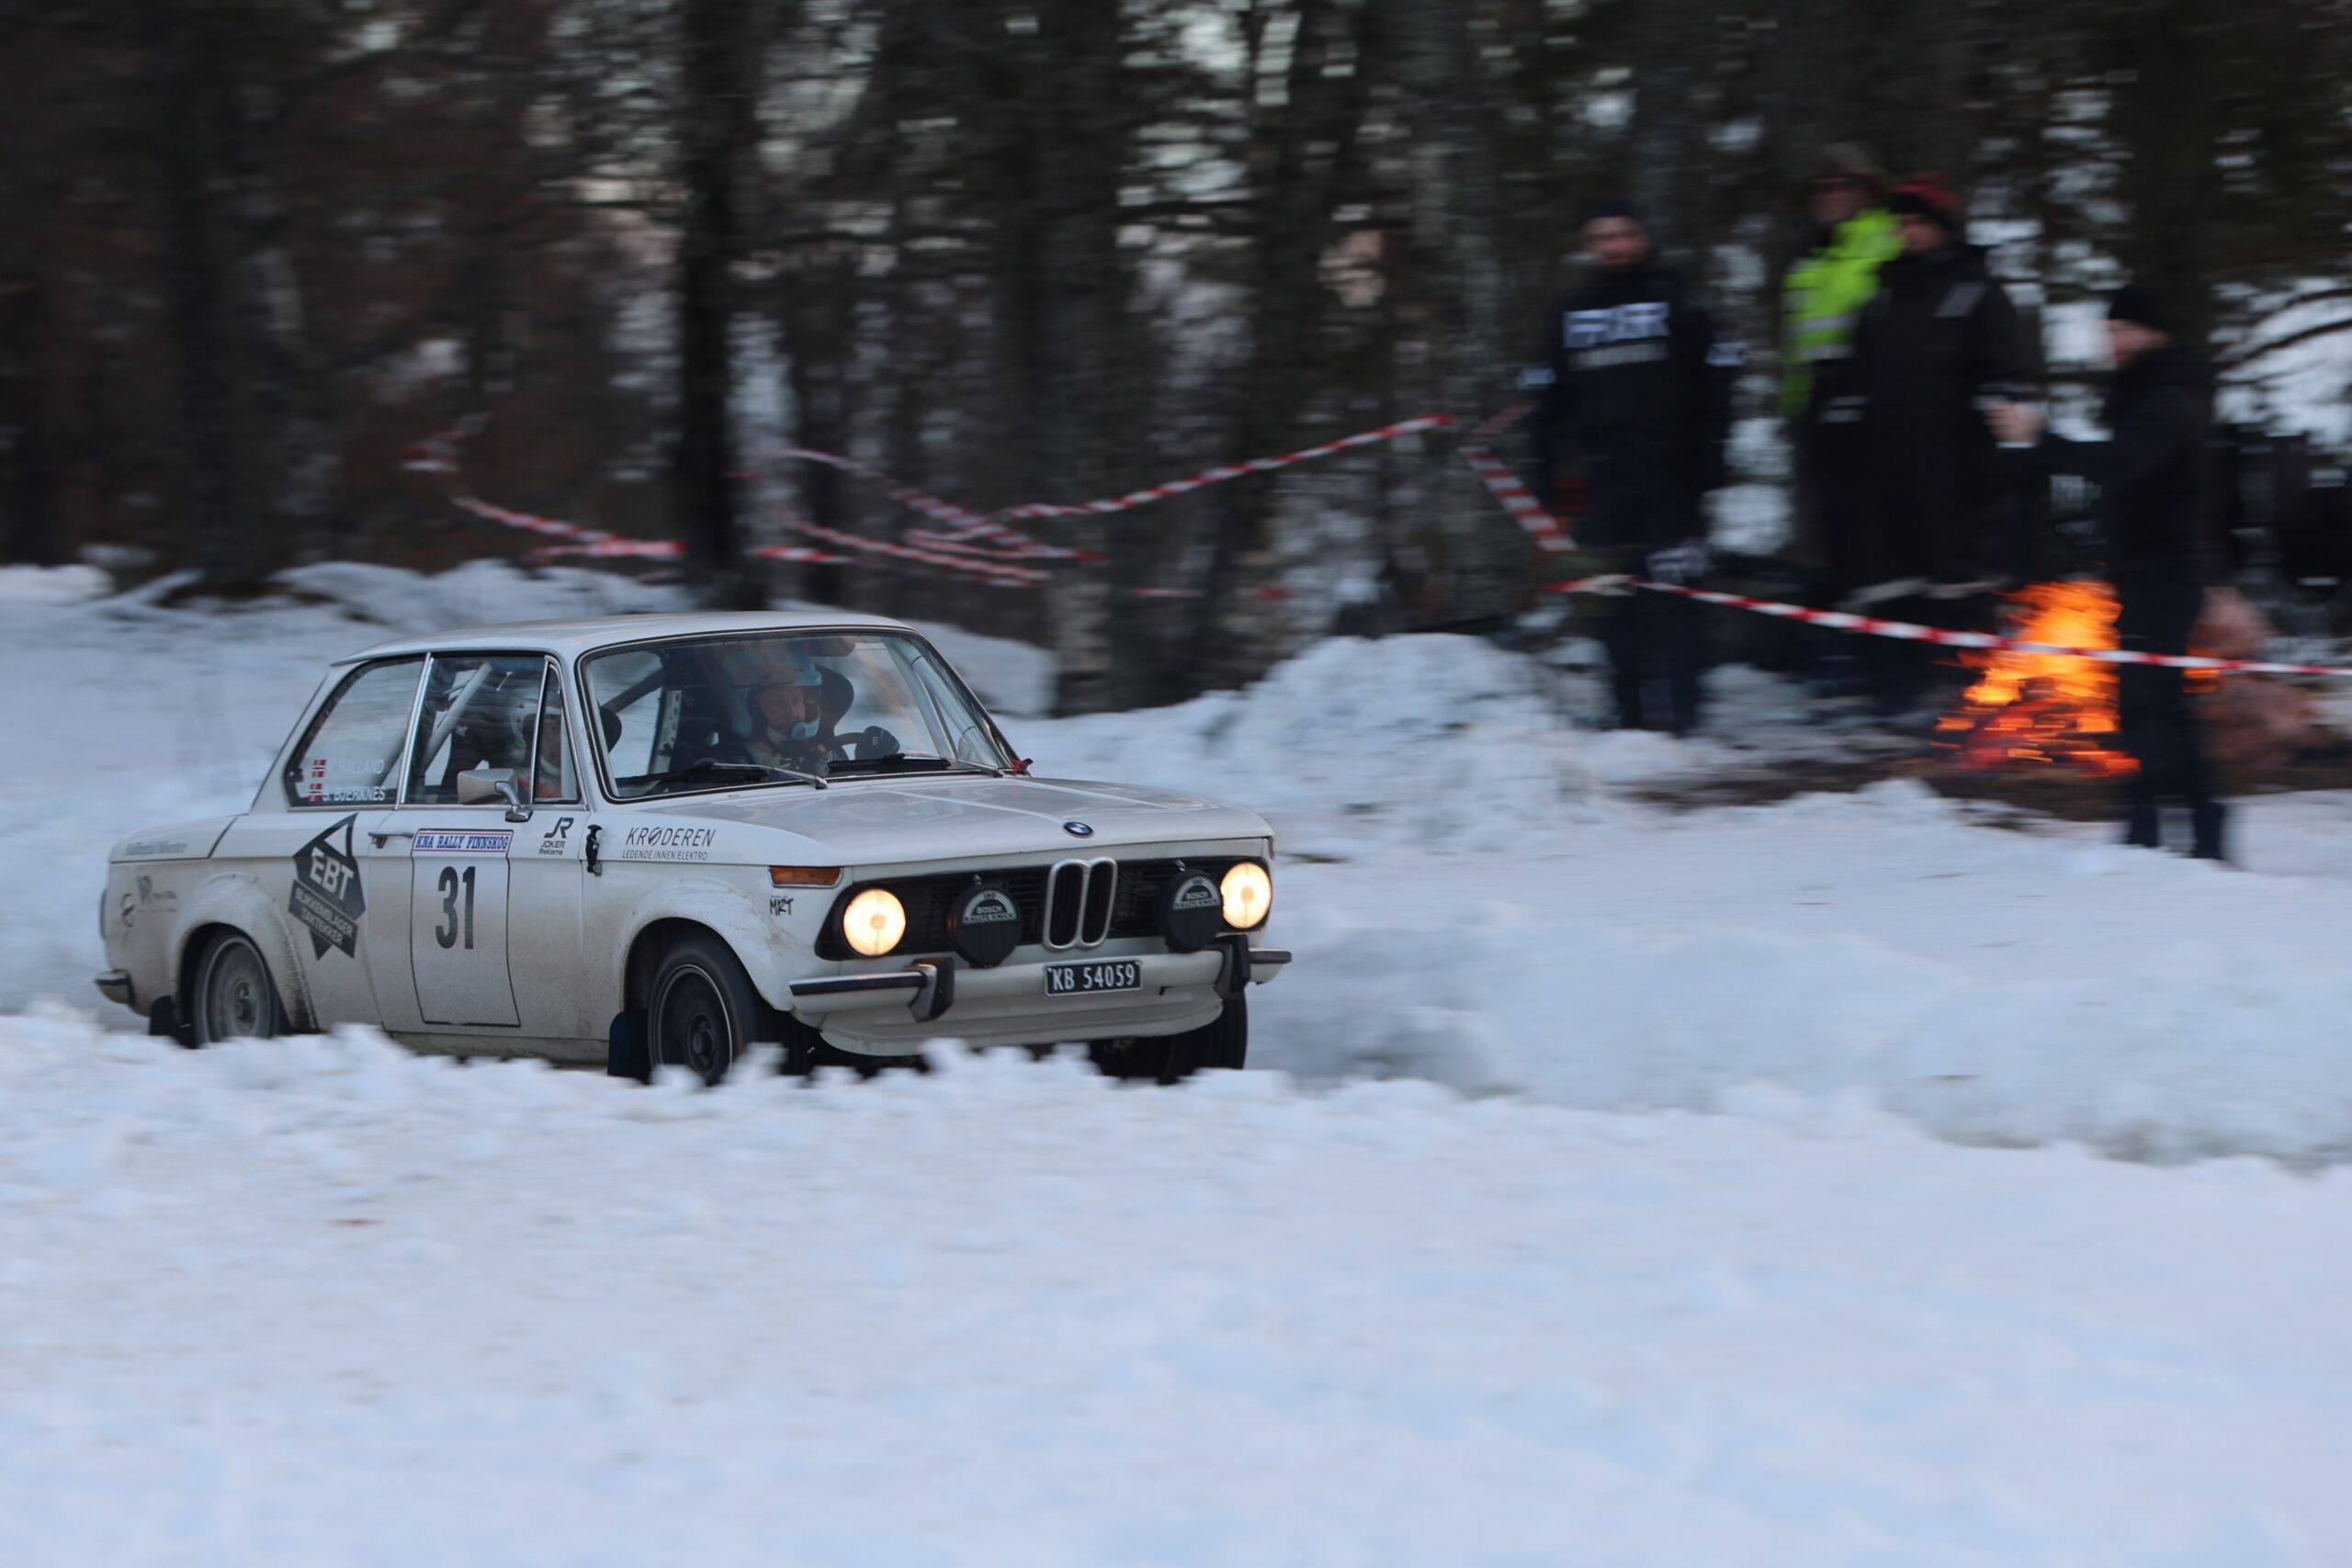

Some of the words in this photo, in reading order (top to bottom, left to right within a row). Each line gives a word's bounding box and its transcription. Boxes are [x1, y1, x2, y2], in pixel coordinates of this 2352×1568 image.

[415, 836, 434, 848] KNA
[436, 836, 466, 849] RALLY
[466, 837, 509, 850] FINNSKOG
[626, 827, 717, 847] KRØDEREN
[540, 840, 566, 849] JOKER
[538, 848, 564, 856] Reklame
[622, 850, 653, 860] LEDENDE
[654, 851, 676, 860] INNEN
[677, 852, 708, 861] ELEKTRO
[309, 847, 355, 901] EBT
[1185, 890, 1208, 900] BOSCH
[435, 865, 476, 950] 31
[977, 903, 1001, 914] BOSCH
[1052, 966, 1075, 991] KB
[1083, 964, 1135, 988] 54059
